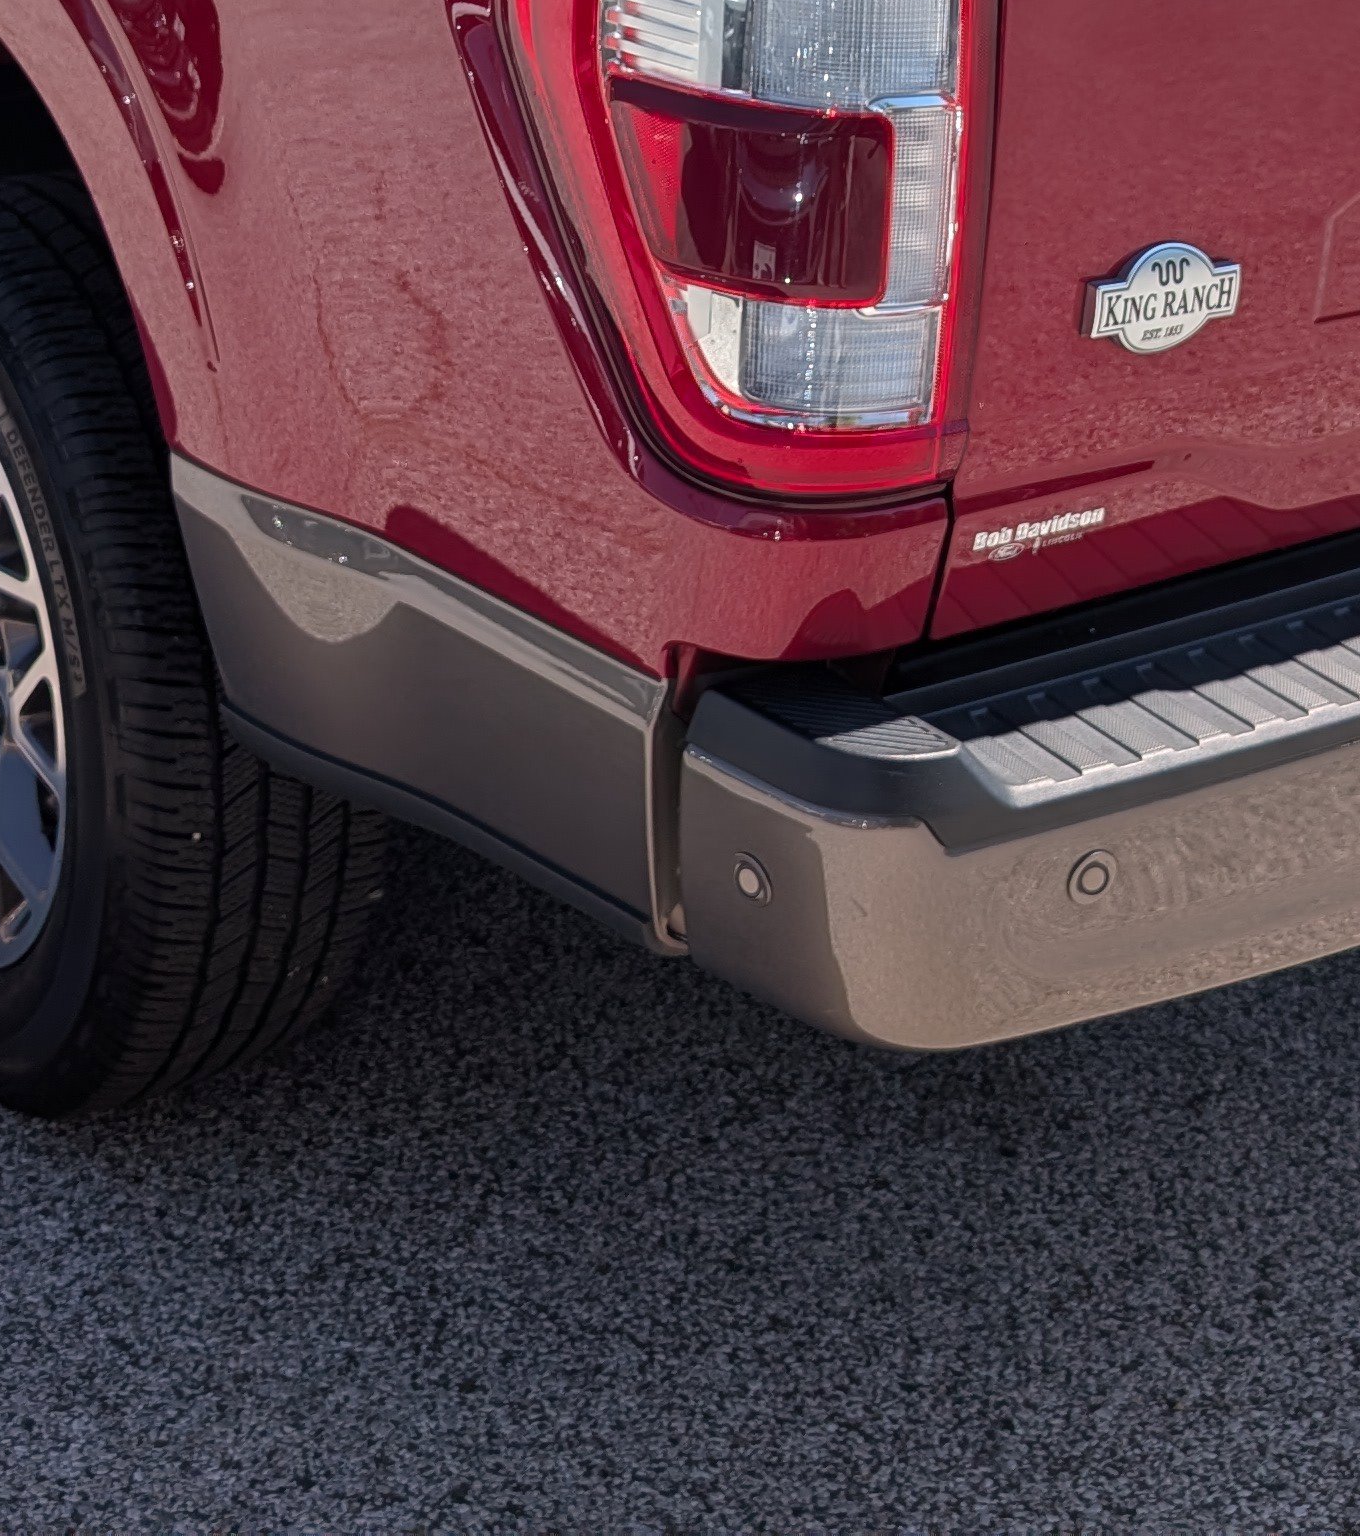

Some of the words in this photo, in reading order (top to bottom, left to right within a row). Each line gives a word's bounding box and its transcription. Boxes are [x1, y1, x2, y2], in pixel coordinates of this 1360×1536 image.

[1103, 293, 1158, 328] KING
[1161, 276, 1234, 318] RANCH
[4, 429, 56, 553] DEFENDER
[47, 559, 71, 610] LTX
[973, 527, 1013, 551] Bob
[1014, 507, 1105, 541] Davidson
